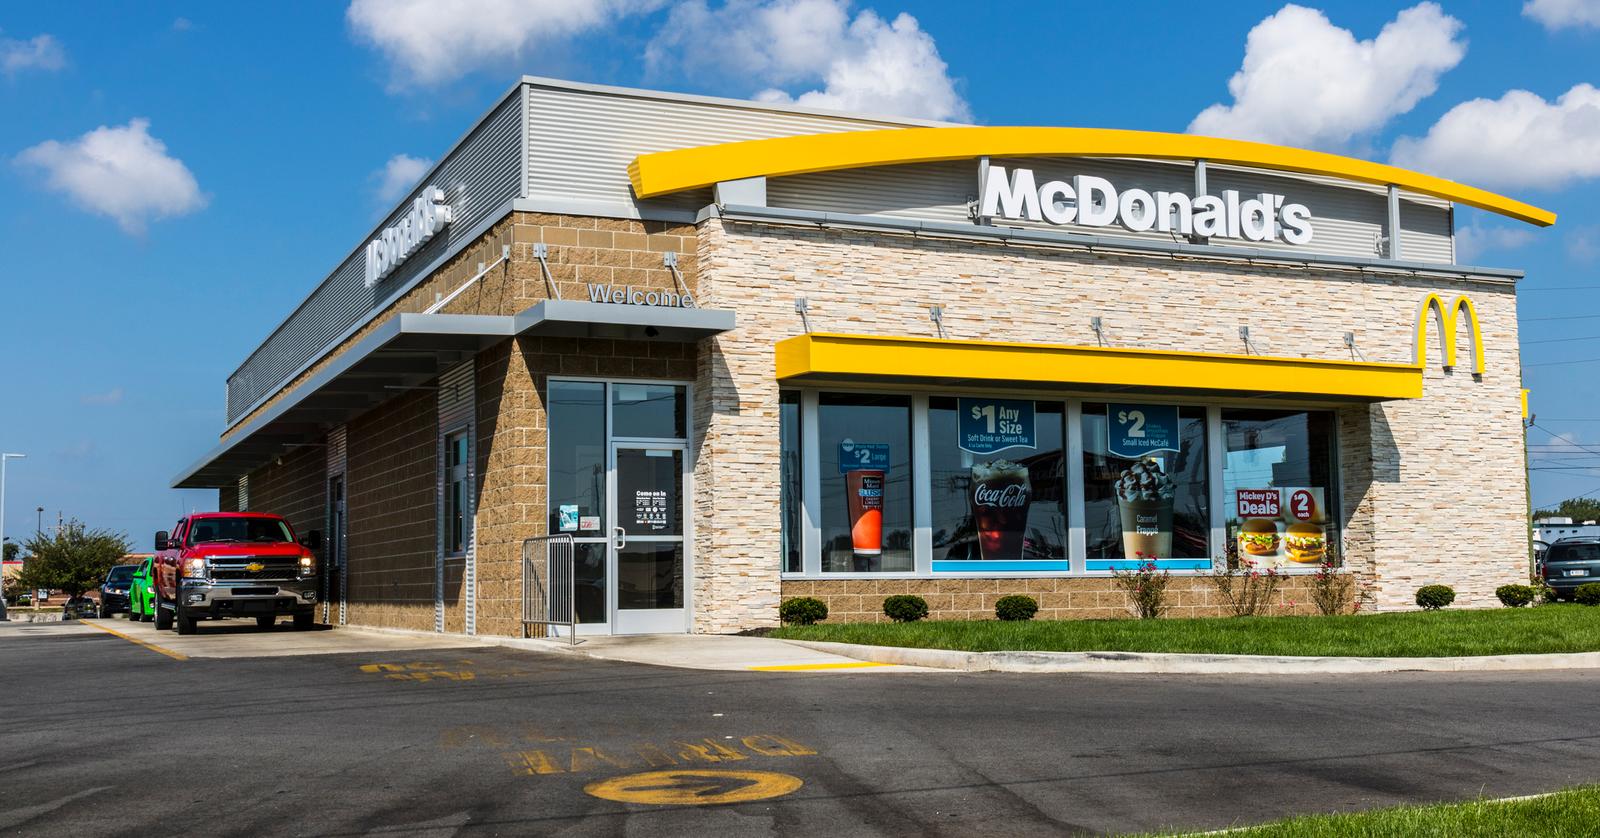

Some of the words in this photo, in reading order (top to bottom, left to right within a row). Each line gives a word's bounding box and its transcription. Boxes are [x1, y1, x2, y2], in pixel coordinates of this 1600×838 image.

[979, 165, 1314, 245] McDonald's
[588, 282, 696, 308] Welcome
[971, 405, 996, 433] $1
[999, 406, 1019, 422] Any
[999, 421, 1022, 434] Size
[1118, 410, 1145, 437] $2
[967, 434, 978, 442] Soft
[979, 434, 994, 442] Drink
[1001, 435, 1018, 443] Sweet
[854, 449, 870, 463] $2
[1239, 491, 1265, 501] Mickey
[1266, 491, 1278, 500] D's
[1293, 493, 1309, 511] $2
[1239, 501, 1278, 514] Deals
